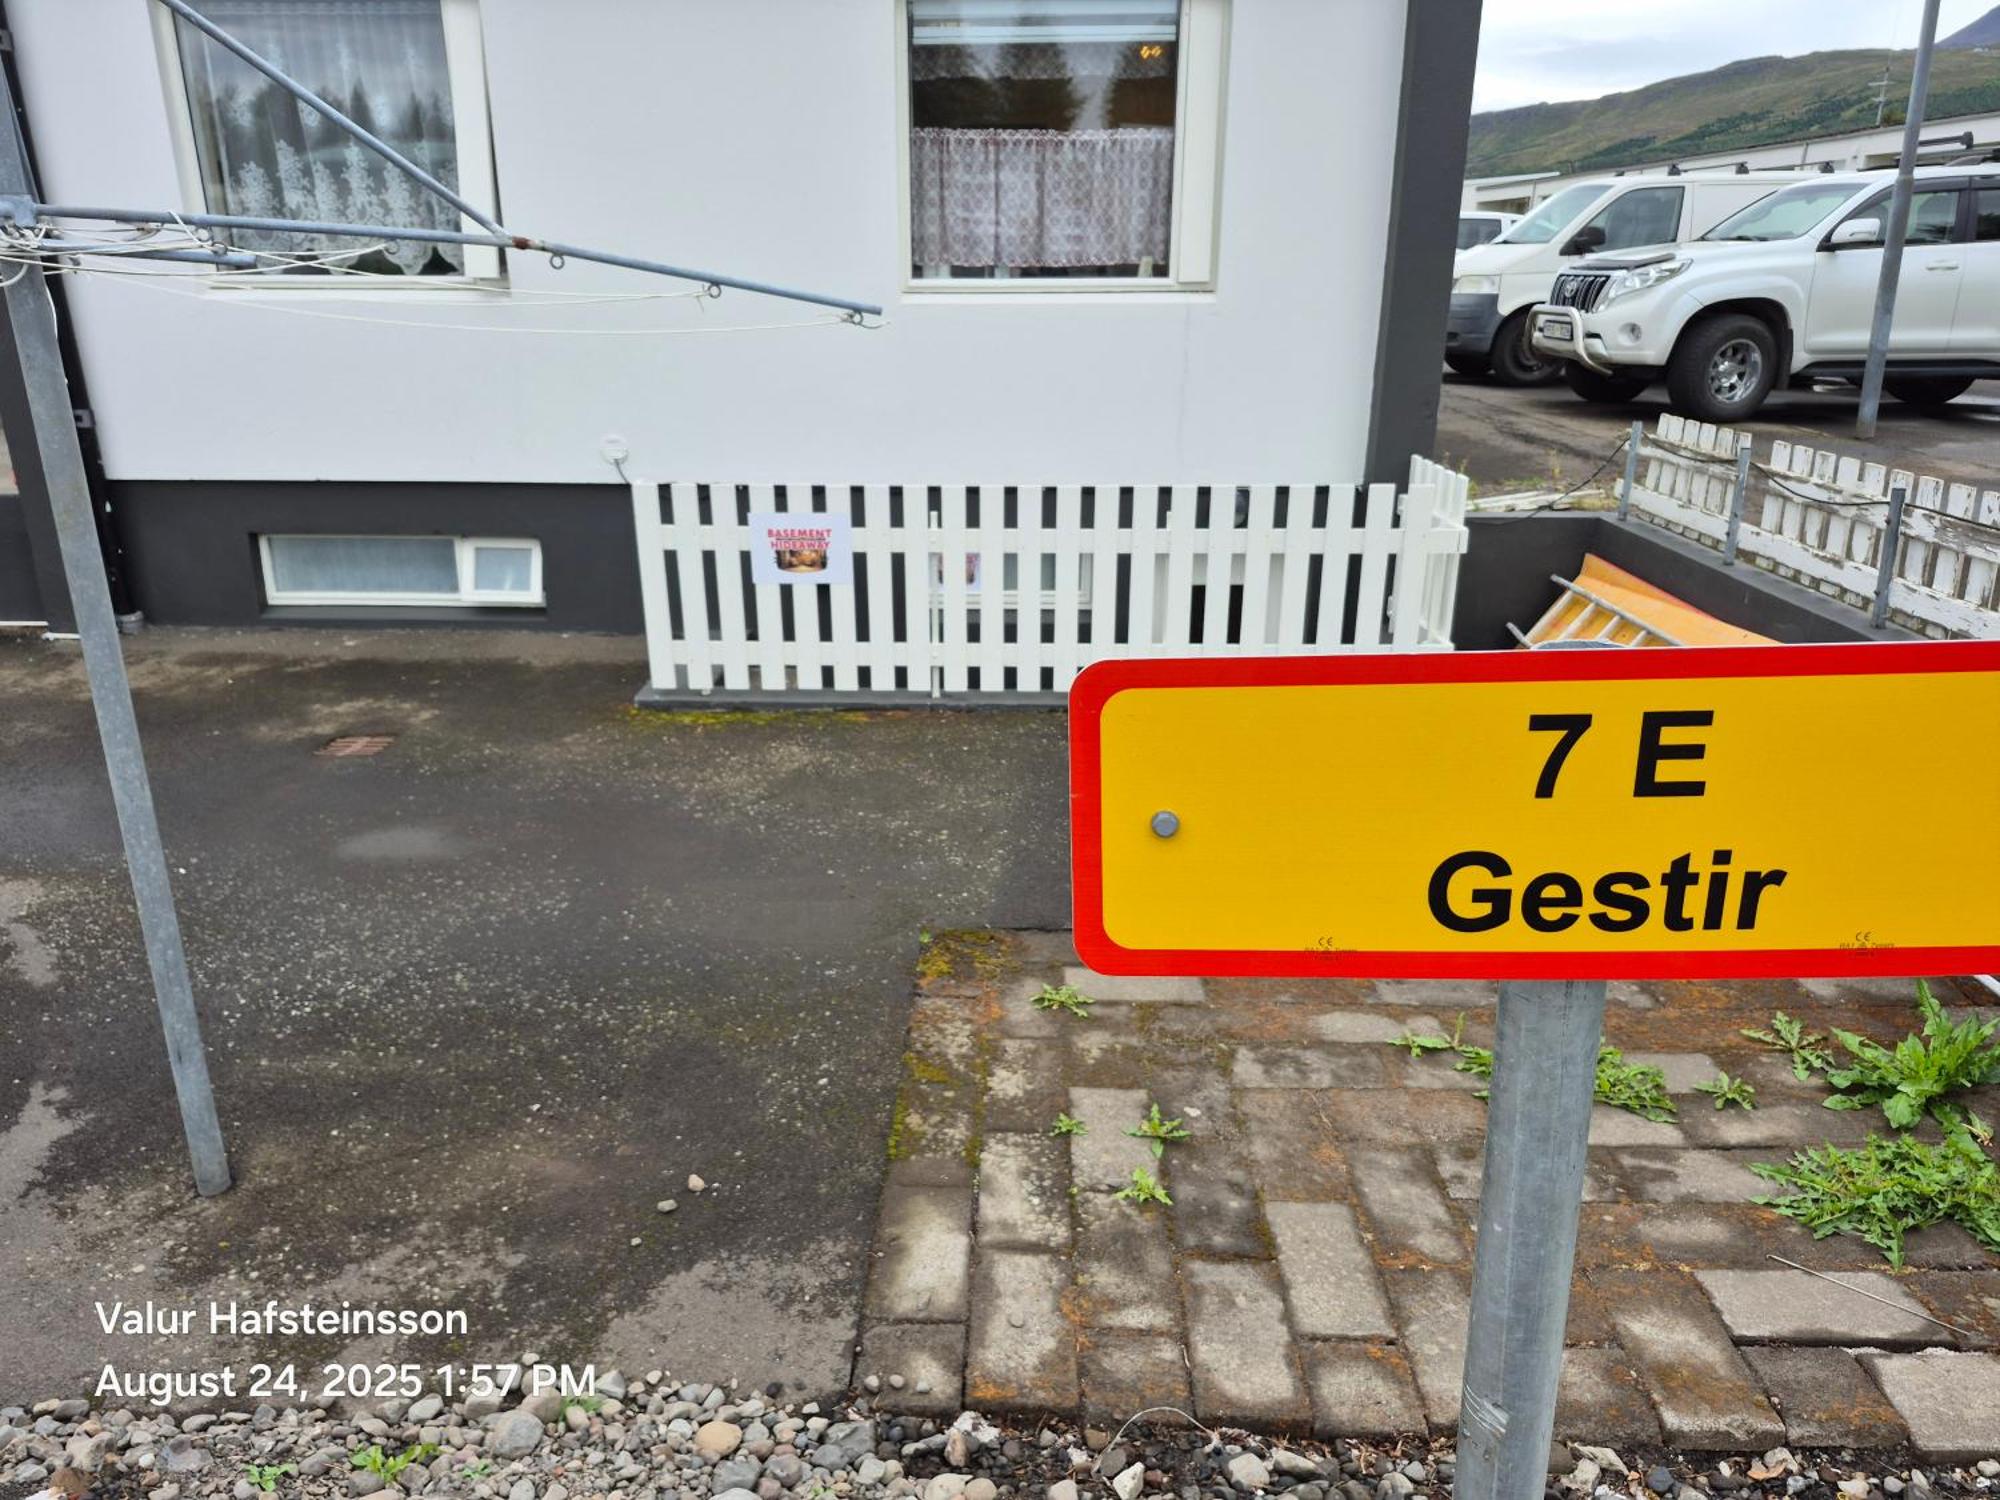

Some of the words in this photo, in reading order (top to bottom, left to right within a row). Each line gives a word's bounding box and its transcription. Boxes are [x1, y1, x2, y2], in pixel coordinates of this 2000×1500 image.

[767, 528, 832, 538] BASEMENT
[770, 541, 831, 550] HIDEAWAY
[1528, 713, 1593, 799] 7
[1633, 710, 1714, 798] E
[1427, 849, 1788, 933] Gestir
